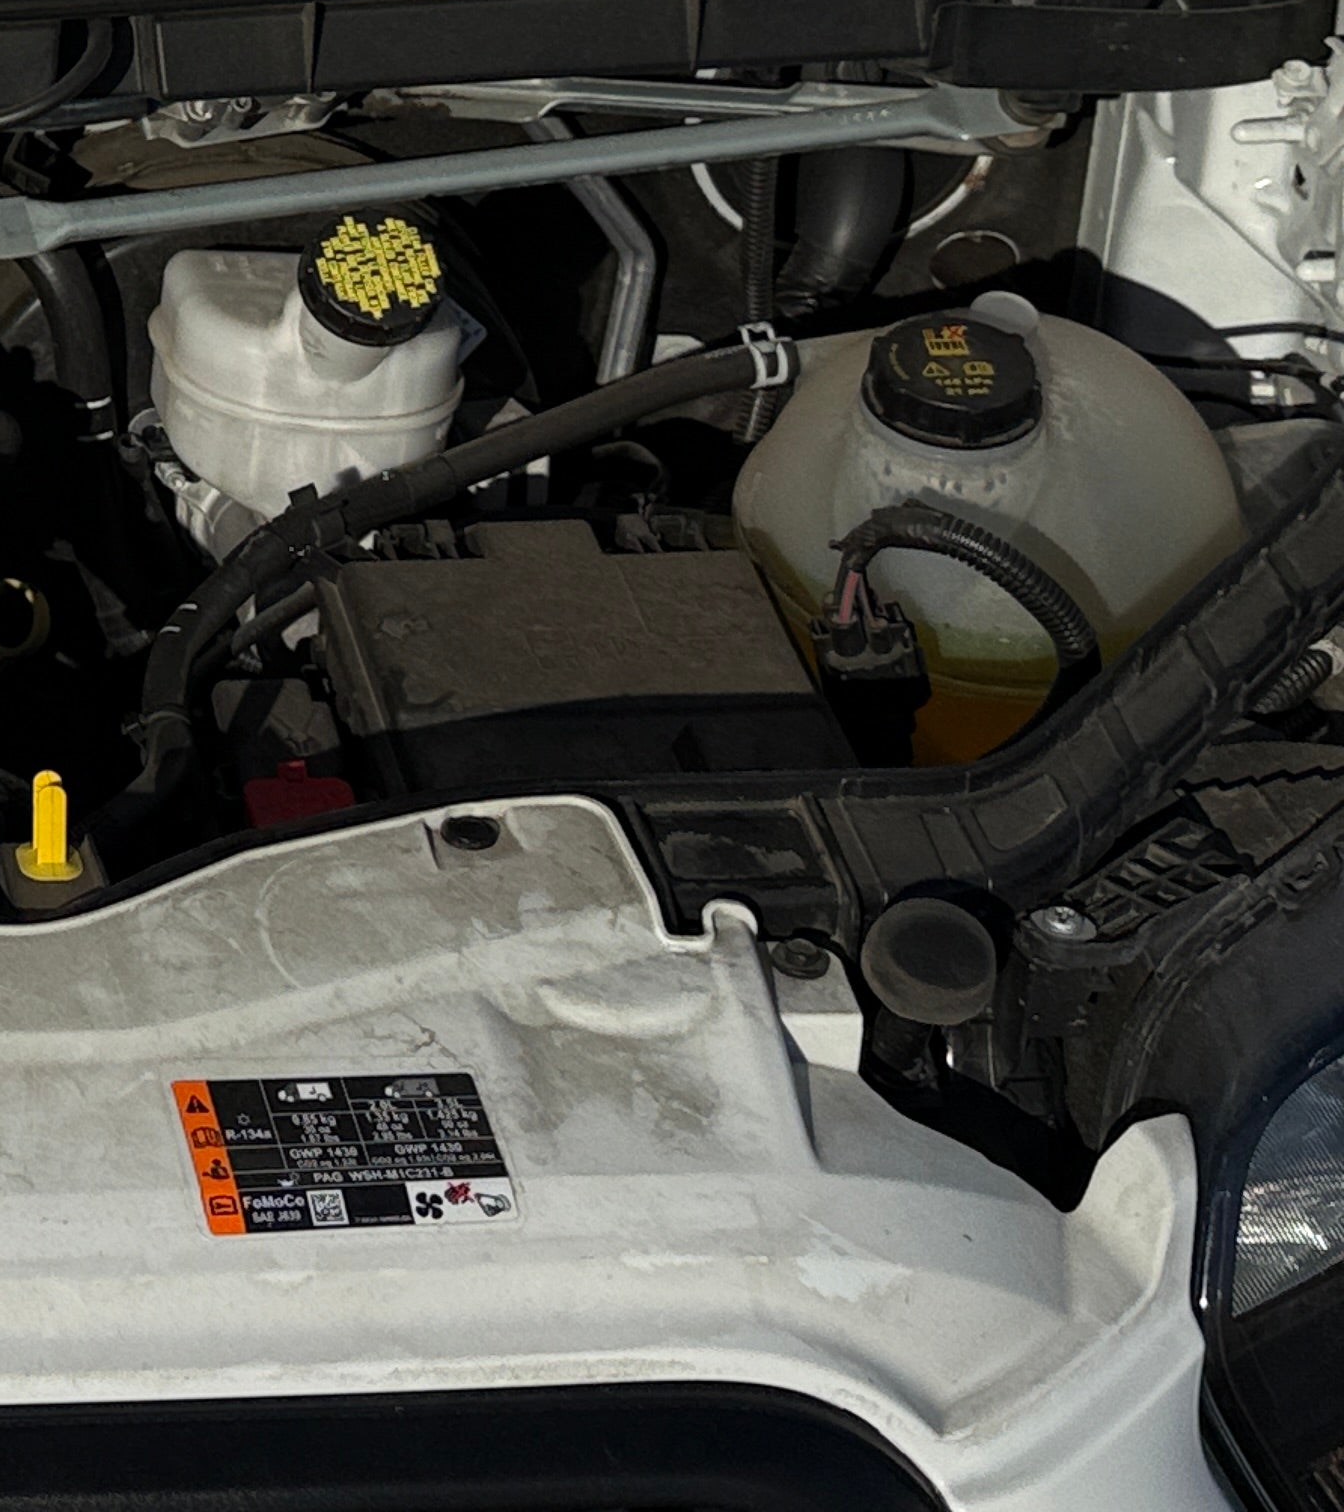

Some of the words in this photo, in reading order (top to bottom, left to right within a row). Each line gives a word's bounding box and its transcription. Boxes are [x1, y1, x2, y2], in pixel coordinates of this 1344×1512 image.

[225, 1128, 273, 1141] R-134a
[289, 1147, 323, 1159] GWP
[394, 1143, 427, 1156] GWP
[313, 1171, 344, 1183] PAG
[243, 1195, 305, 1210] FoMoCo
